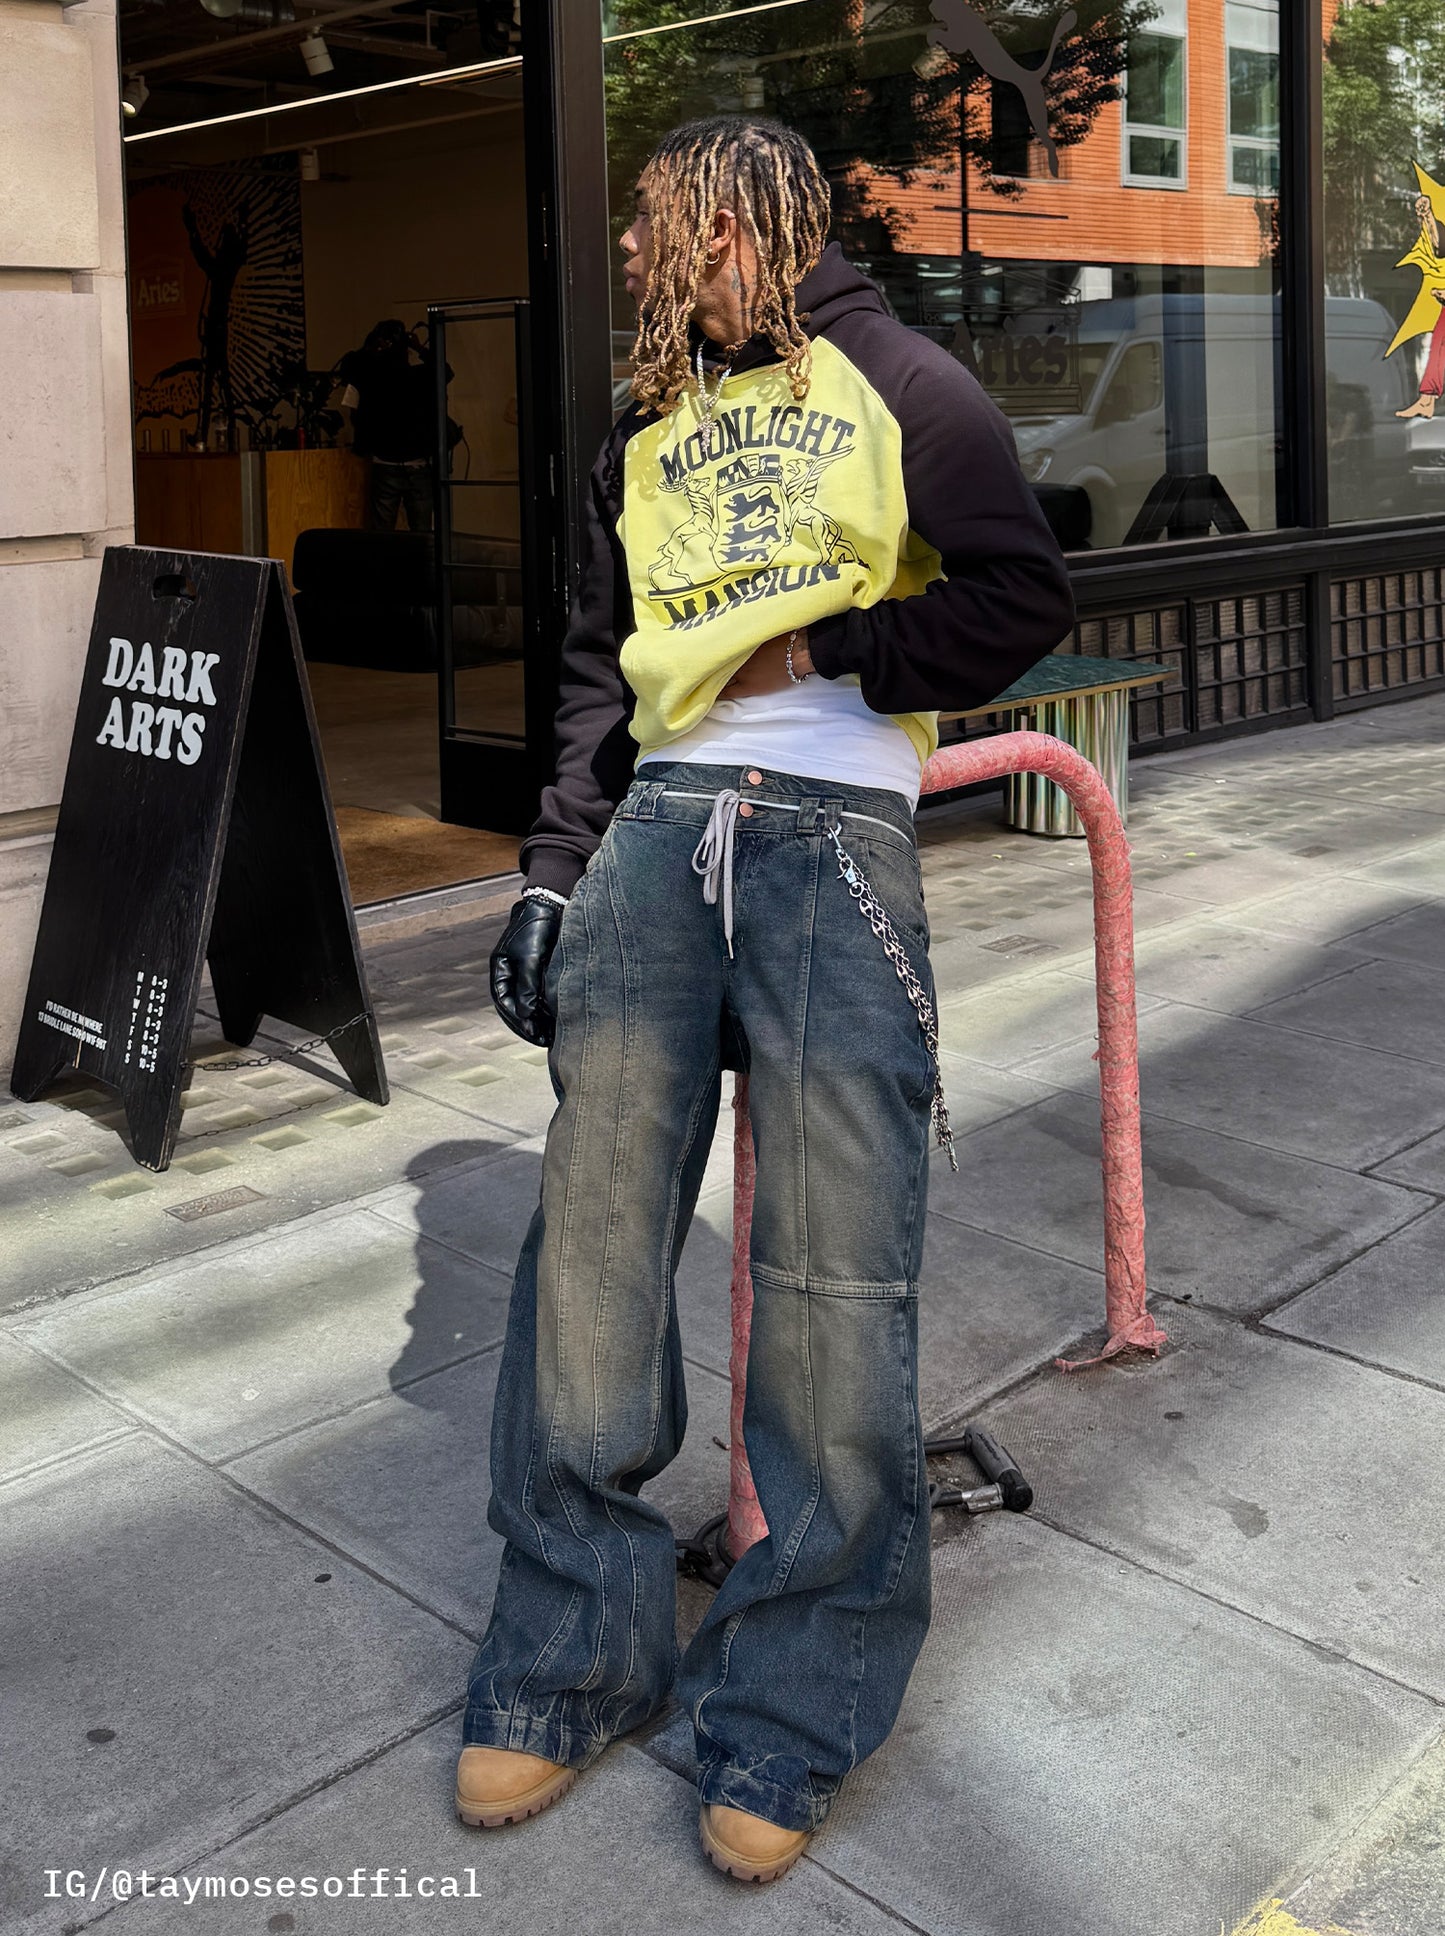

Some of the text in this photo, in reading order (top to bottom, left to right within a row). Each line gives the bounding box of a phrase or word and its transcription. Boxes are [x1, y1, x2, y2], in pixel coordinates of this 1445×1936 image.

[137, 276, 180, 307] Aries
[951, 315, 1068, 385] Aries
[659, 405, 856, 481] MOONLIGHT
[102, 637, 220, 706] DARK
[96, 696, 206, 765] ARTS
[137, 971, 144, 983] M
[136, 985, 141, 996] T
[133, 998, 140, 1010] W
[71, 1011, 79, 1023] BE
[132, 1012, 137, 1023] T
[60, 1021, 73, 1035] LANE
[129, 1025, 135, 1036] F
[127, 1039, 132, 1051] S
[125, 1053, 130, 1064] S
